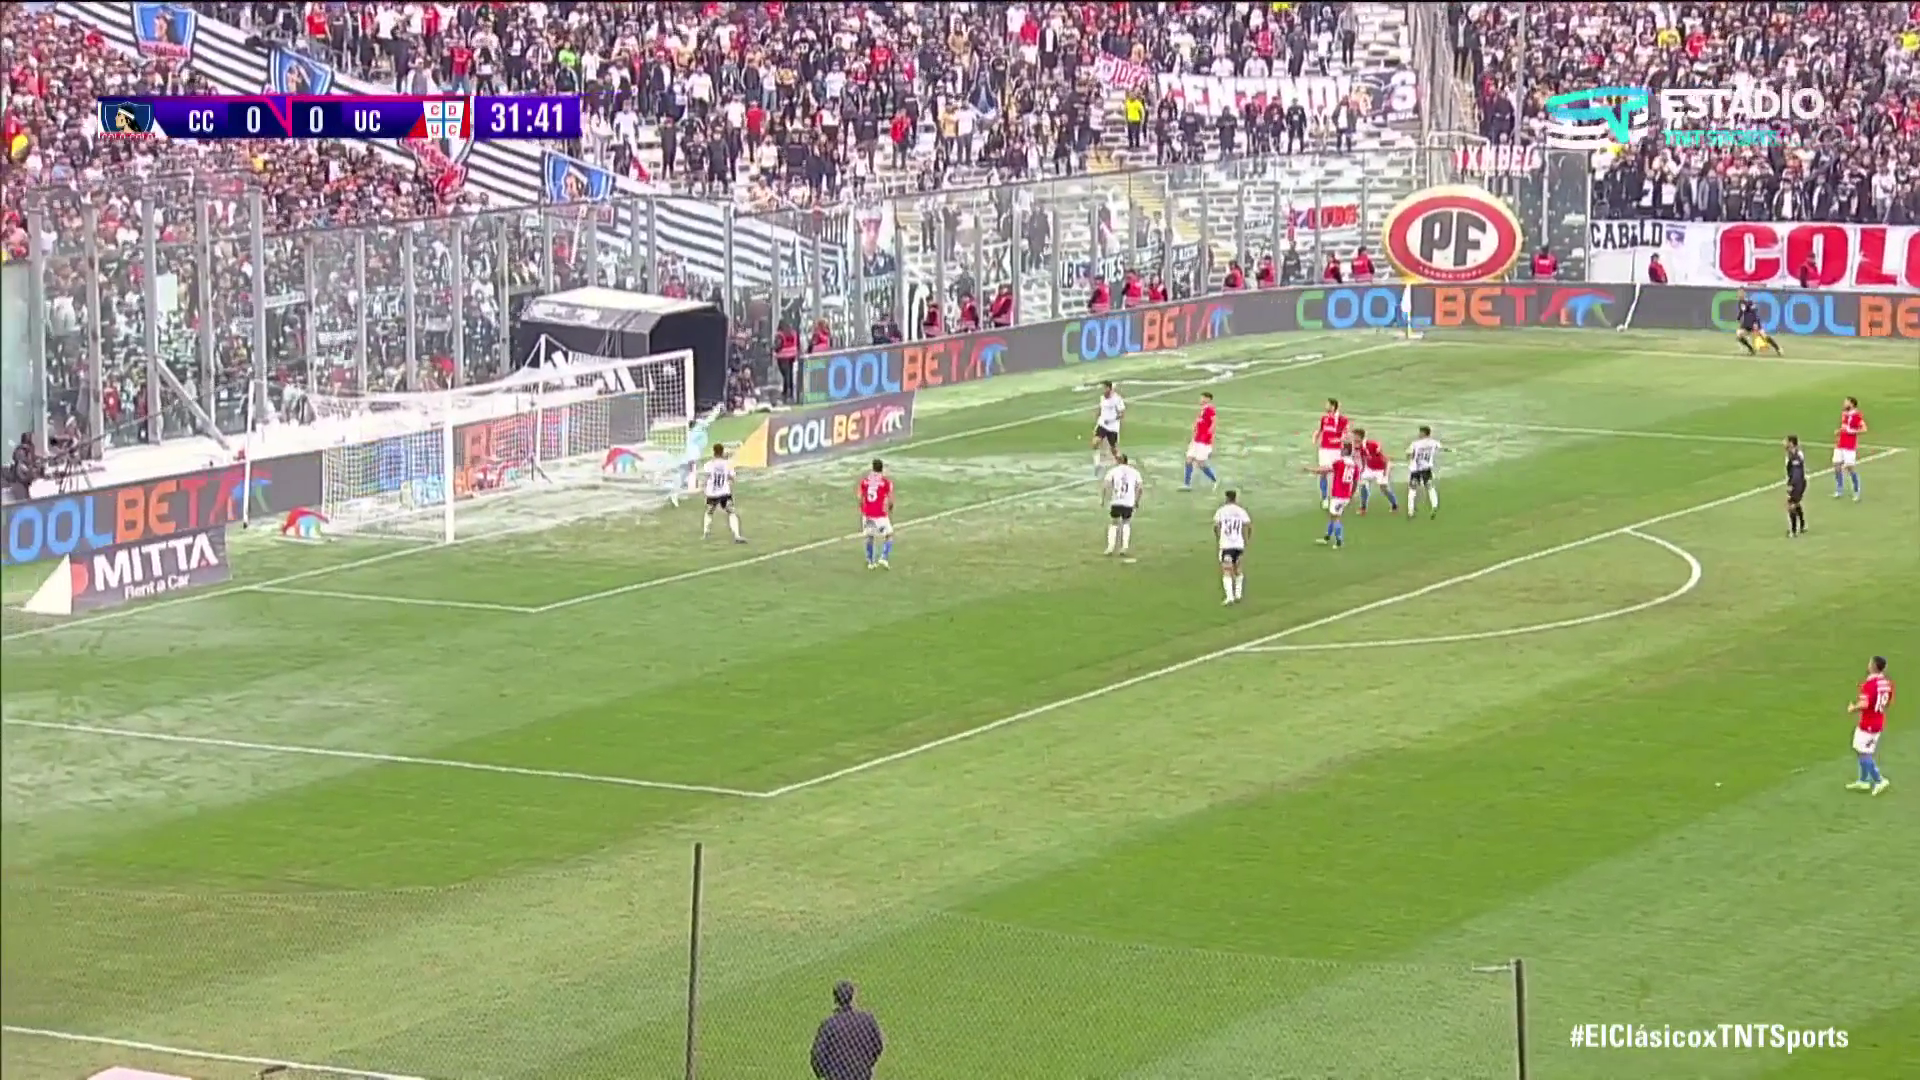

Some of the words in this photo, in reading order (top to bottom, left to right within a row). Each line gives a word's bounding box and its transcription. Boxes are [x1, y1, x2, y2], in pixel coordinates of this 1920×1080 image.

[1420, 211, 1487, 267] PF
[1718, 224, 1920, 286] COL
[1061, 303, 1198, 365] COOLBET
[1296, 286, 1537, 329] COOLBET
[803, 341, 963, 404] COOLBET
[774, 408, 876, 456] COOLBET
[0, 479, 208, 563] OOLBET
[1224, 518, 1242, 537] 34
[93, 532, 219, 592] MITTA
[124, 584, 155, 600] Rent
[168, 573, 191, 590] Car
